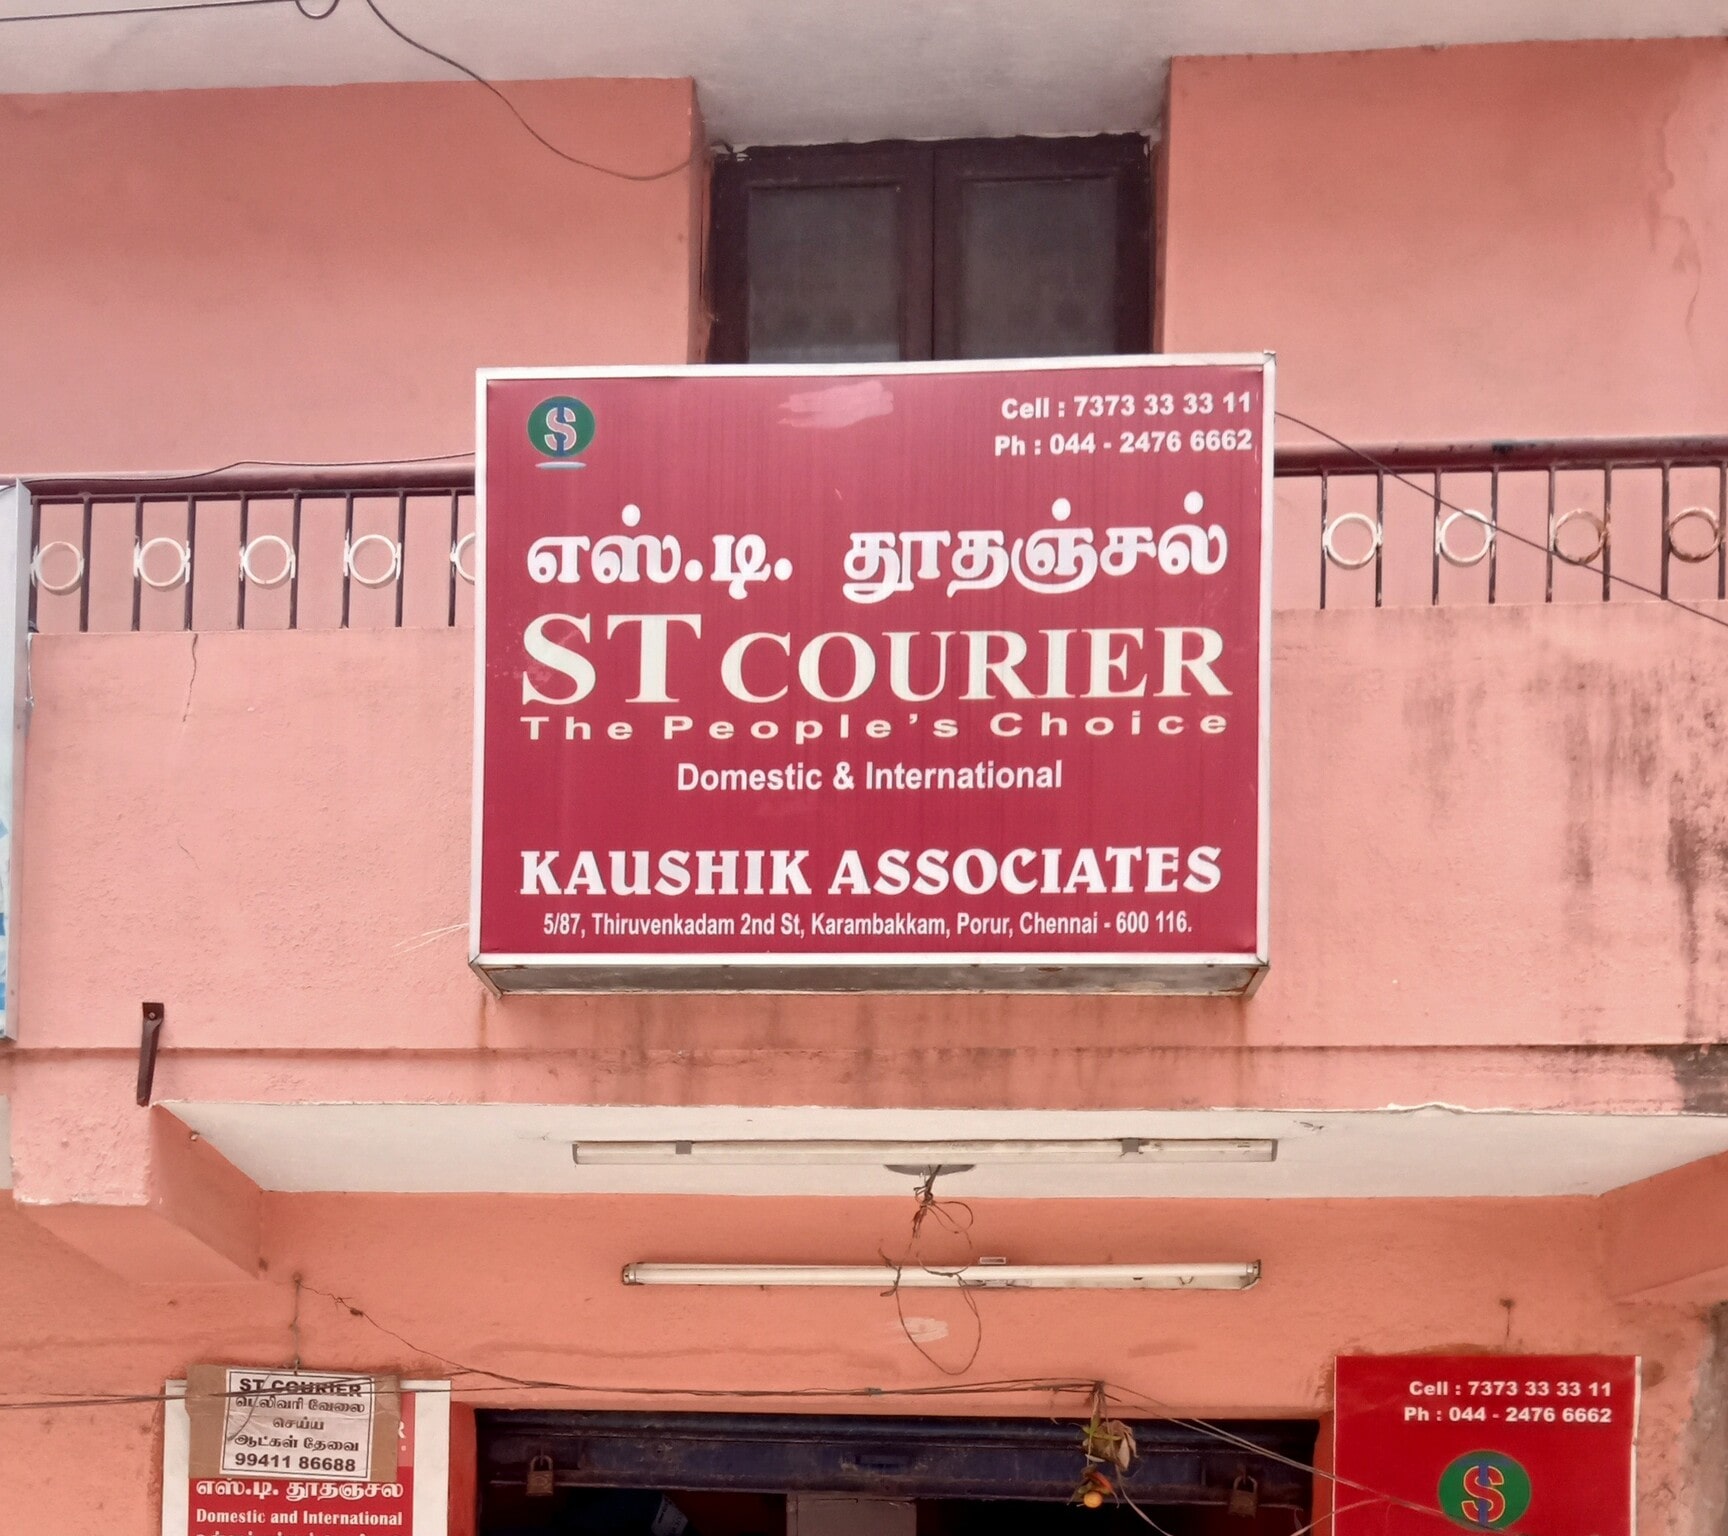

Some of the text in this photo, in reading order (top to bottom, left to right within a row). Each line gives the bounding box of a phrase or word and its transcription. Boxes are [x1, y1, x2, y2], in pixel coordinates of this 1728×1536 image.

[1001, 397, 1050, 420] Cell
[1073, 394, 1136, 417] 7373
[1143, 393, 1175, 416] 33
[1182, 392, 1214, 415] 33
[1223, 391, 1250, 413] 11
[994, 434, 1026, 457] Ph
[1049, 432, 1096, 455] 044
[1119, 430, 1182, 454] 2476
[1189, 428, 1253, 452] 6662
[527, 490, 1228, 604] எஸ்.டி. தூதஞ்சல்
[522, 613, 1233, 706] ST COURIER
[520, 710, 1227, 745] The People's Choice
[677, 759, 1063, 791] Domestic & International
[520, 845, 1222, 896] KAUSHIK ASSOCIATES
[543, 912, 586, 938] 5/87,
[591, 912, 735, 936] Thiruvenkadam
[740, 912, 775, 935] 2nd
[780, 912, 805, 938] St,
[811, 912, 951, 938] Karambakkam,
[956, 912, 1014, 938] Porur,
[1019, 911, 1098, 935] Chennai
[1115, 910, 1150, 934] 600
[1155, 910, 1192, 933] 116.
[239, 1378, 362, 1398] ST COURIER
[1409, 1380, 1449, 1396] Cell
[1467, 1380, 1519, 1397] 7373
[1524, 1380, 1550, 1397] 33
[1556, 1381, 1582, 1397] 33
[1588, 1381, 1611, 1397] 11
[1404, 1406, 1430, 1422] Ph
[1448, 1406, 1487, 1422] 044
[1505, 1406, 1556, 1423] 2476
[1562, 1407, 1612, 1423] 6662
[234, 1452, 357, 1472] 99411 86688
[196, 1508, 403, 1526] Domestic and International
